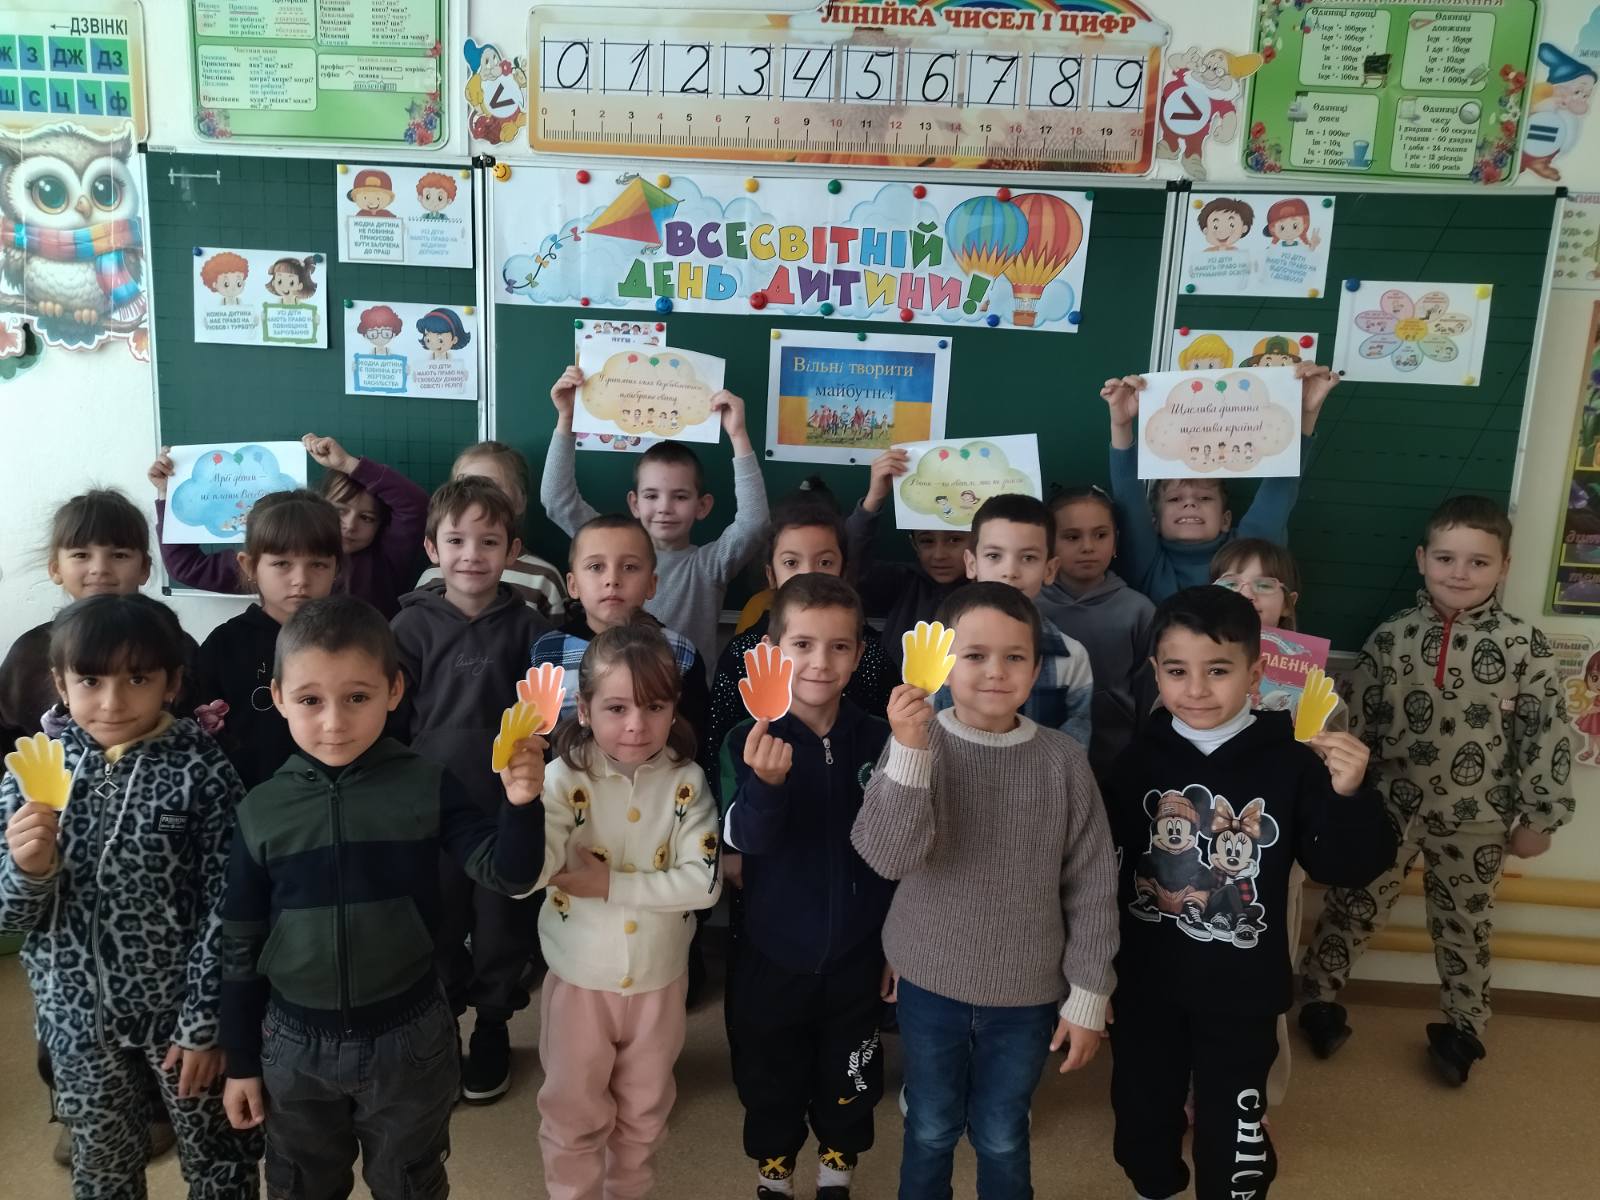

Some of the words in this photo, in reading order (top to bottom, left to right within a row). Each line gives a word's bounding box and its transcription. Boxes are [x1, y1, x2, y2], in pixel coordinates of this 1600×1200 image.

[70, 17, 128, 36] ДЗВІНКІ
[821, 4, 937, 28] ЛІНІЙКА
[943, 9, 1036, 31] ЧИСЕЛ
[1042, 15, 1053, 31] І
[1058, 15, 1137, 36] ЦИФР
[557, 42, 589, 89] 0
[630, 44, 650, 91] 1
[680, 44, 711, 94] 2
[737, 47, 771, 95] 3
[792, 49, 833, 98] 4
[855, 51, 894, 99] 5
[921, 53, 955, 103] 6
[984, 55, 1019, 104] 7
[1048, 57, 1082, 107] 8
[1107, 60, 1143, 108] 9
[541, 107, 548, 117] 0
[570, 108, 576, 117] 1
[599, 110, 606, 119] 2
[628, 111, 635, 120] 3
[657, 112, 664, 122] 4
[686, 113, 693, 122] 5
[715, 114, 722, 123] 6
[744, 115, 751, 124] 7
[773, 116, 781, 126] 8
[803, 118, 810, 127] 9
[831, 119, 843, 128] 10
[861, 120, 872, 129] 11
[890, 121, 903, 130] 12
[919, 122, 932, 131] 13
[949, 123, 962, 132] 14
[979, 124, 992, 134] 15
[1009, 126, 1022, 135] 16
[1039, 127, 1053, 135] 17
[1070, 127, 1082, 136] 18
[1100, 128, 1113, 137] 19
[1130, 129, 1144, 138] 20
[665, 221, 944, 269] ВСЕСВІТНІЙ
[618, 258, 738, 301] ДЕНЬ
[760, 264, 991, 316] ДИТИНИ!
[793, 356, 843, 374] Вільні
[848, 363, 914, 379] творити
[815, 384, 894, 402] майбутнє!
[1171, 403, 1218, 416] Щаслива
[1219, 403, 1260, 417] дитина
[1180, 421, 1223, 434] щаслива
[1224, 421, 1263, 437] країна!
